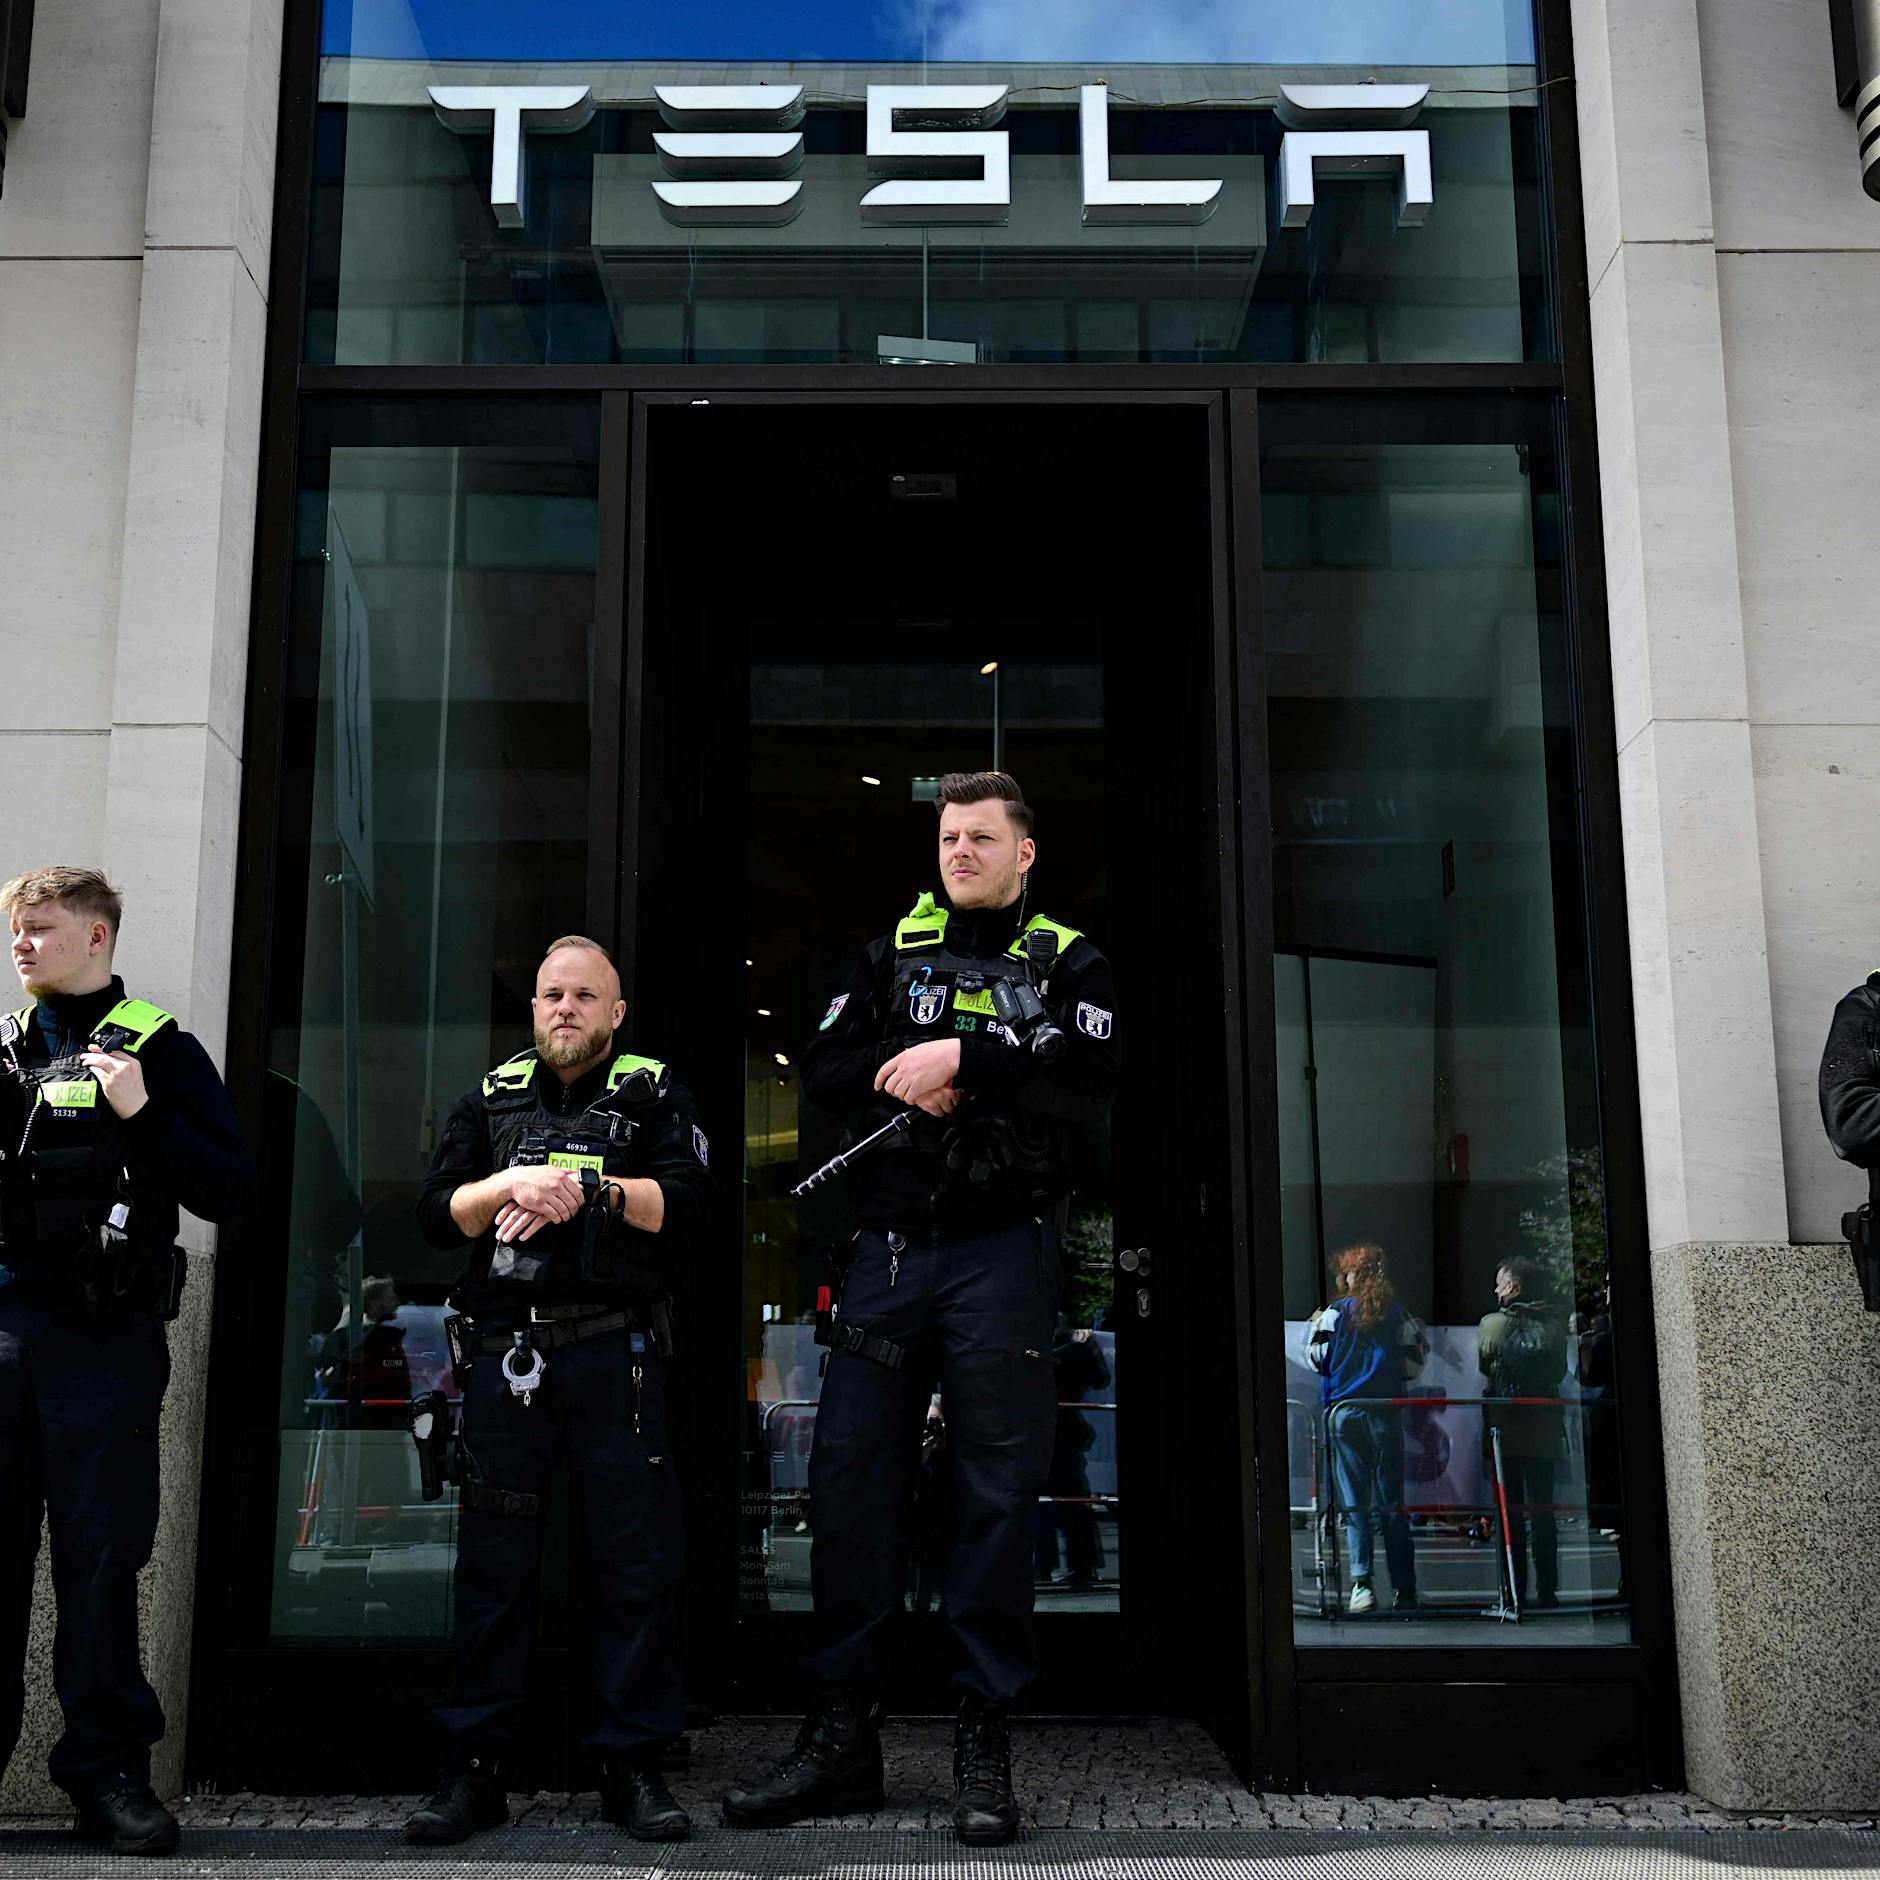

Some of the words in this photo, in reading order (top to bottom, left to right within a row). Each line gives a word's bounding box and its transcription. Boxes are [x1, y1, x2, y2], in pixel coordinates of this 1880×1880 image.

[428, 84, 1433, 208] TESLA
[958, 993, 995, 1011] POLIZ
[999, 990, 1011, 1009] SONY
[954, 1015, 977, 1032] 33
[46, 1085, 93, 1103] LIZEI
[52, 1109, 77, 1117] 51319
[565, 1142, 588, 1152] 46930
[740, 1505, 768, 1514] 10117
[771, 1505, 802, 1515] Berlin
[740, 1545, 777, 1555] SALES
[740, 1576, 785, 1587] Sonntag
